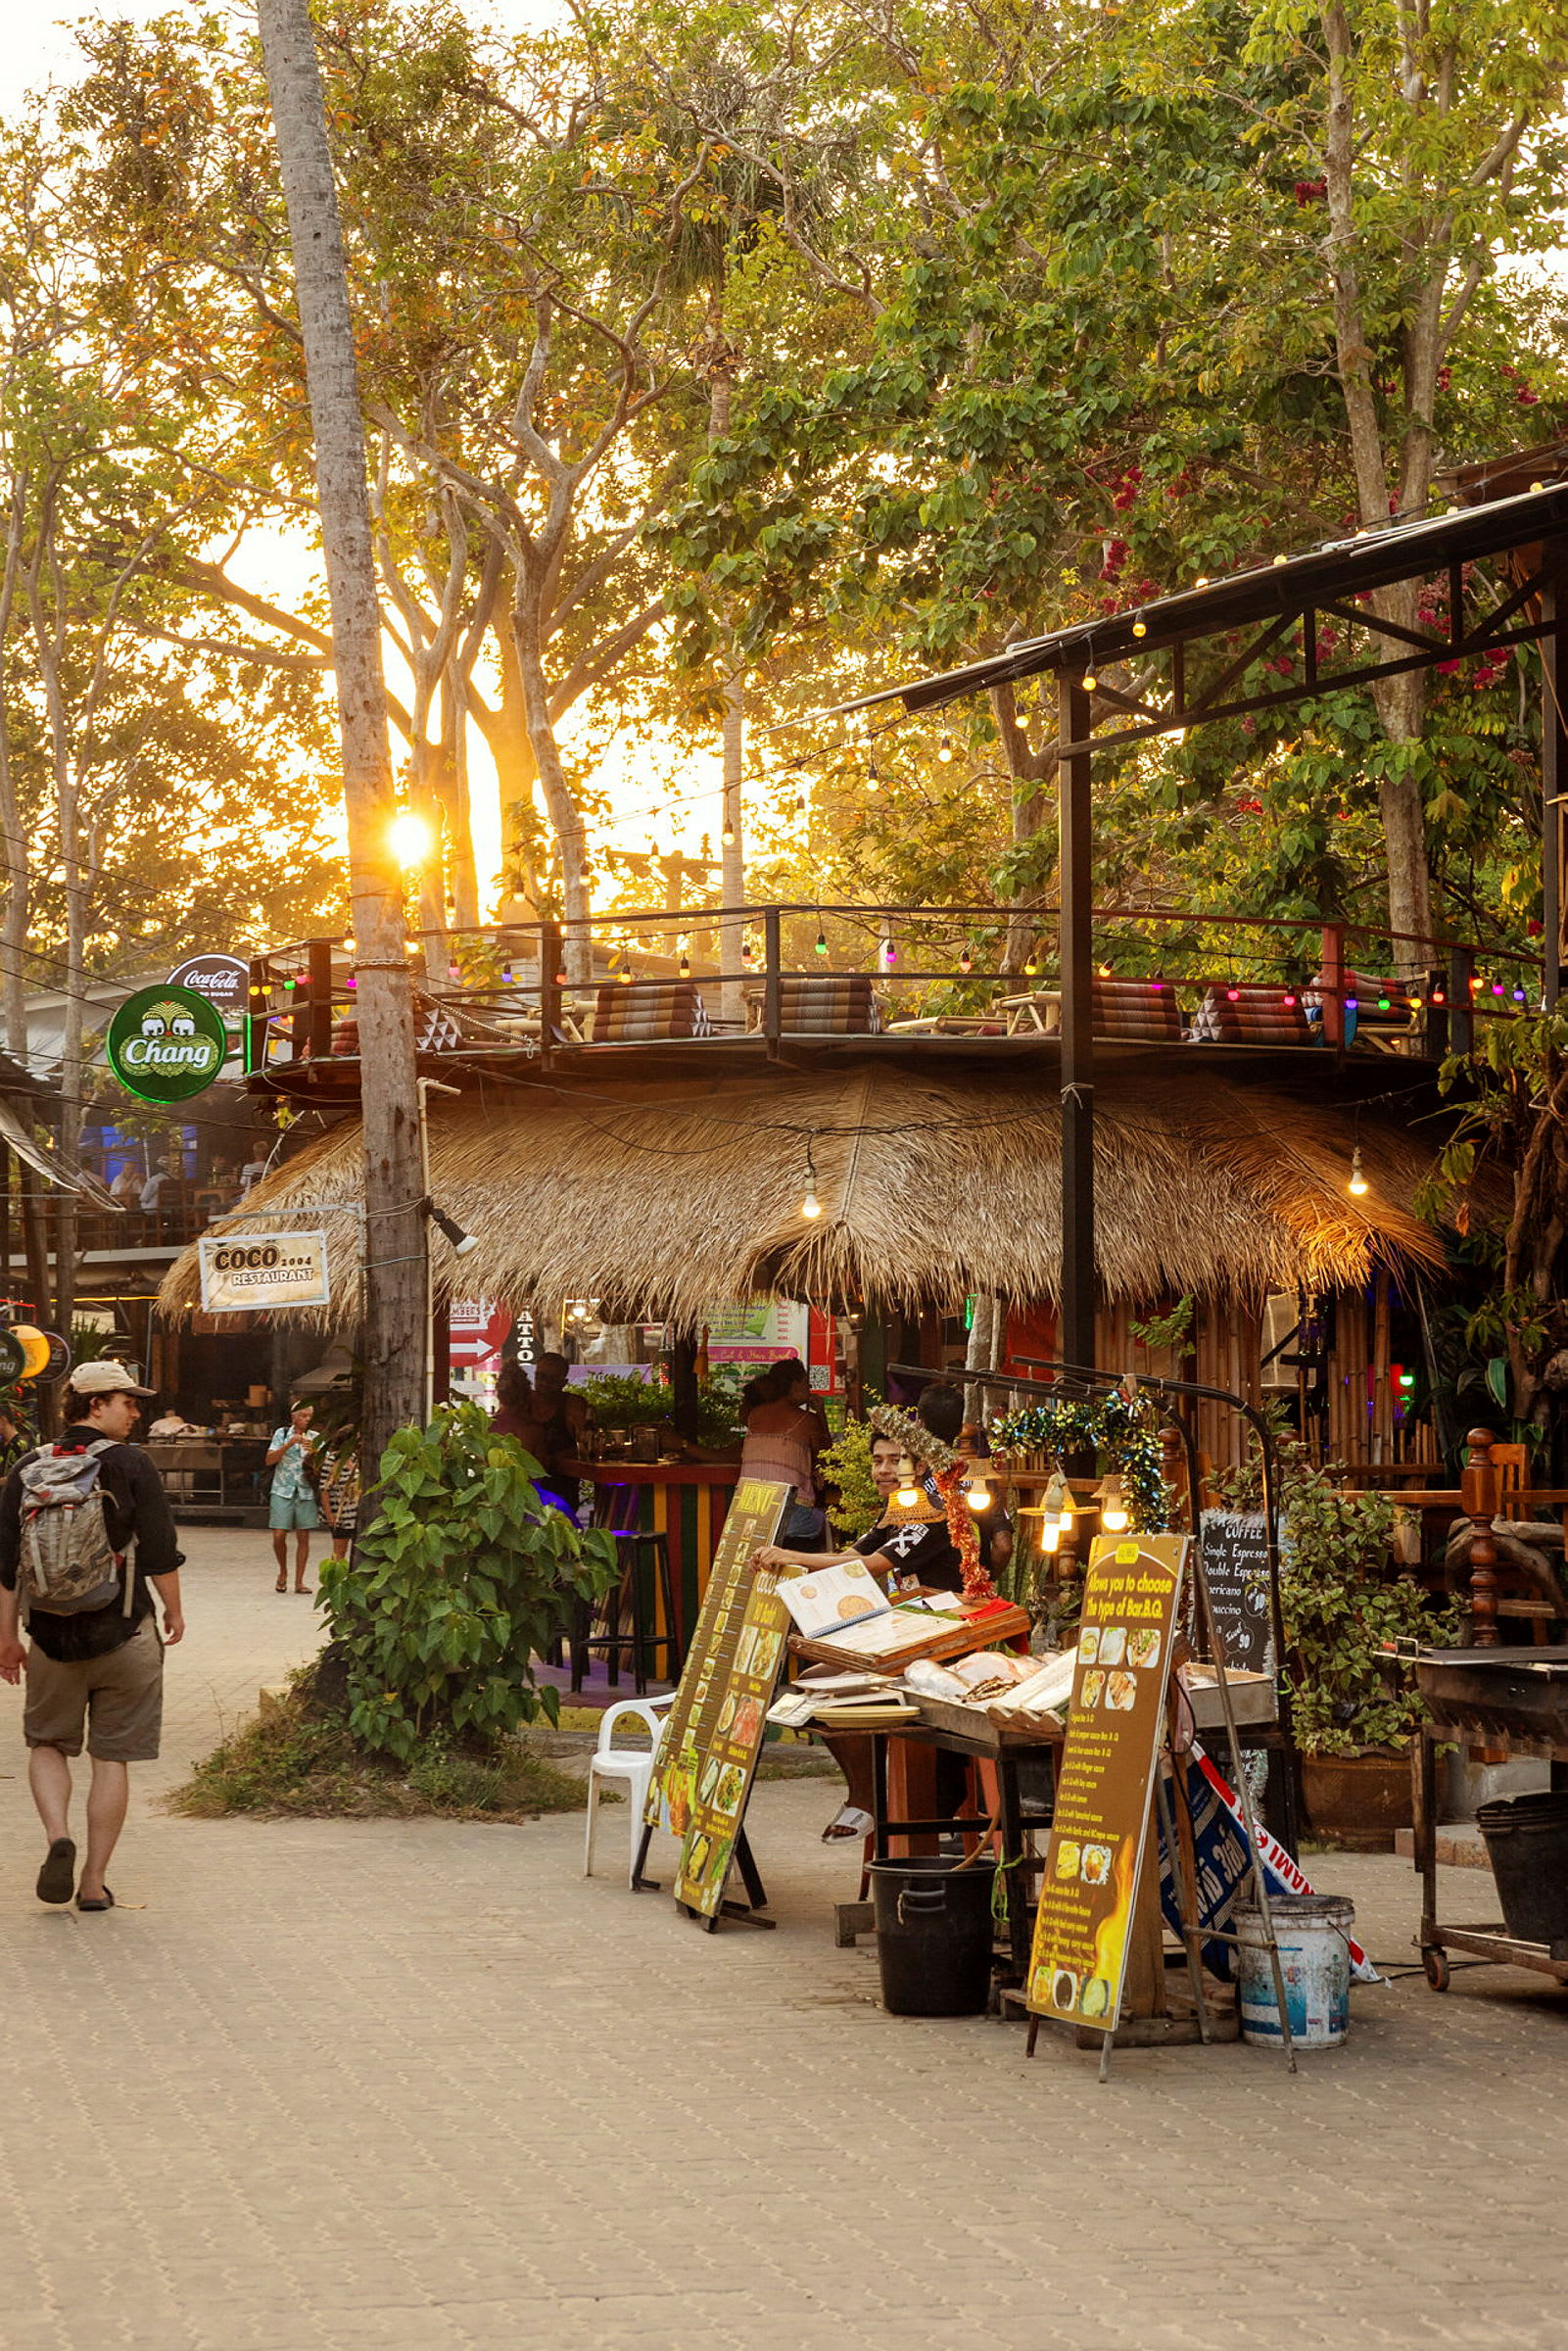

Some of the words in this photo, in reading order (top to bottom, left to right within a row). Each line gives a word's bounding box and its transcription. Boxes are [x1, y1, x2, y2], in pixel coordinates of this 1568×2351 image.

[125, 1038, 211, 1069] Chang
[214, 1245, 280, 1272] COCO
[281, 1256, 312, 1267] 2004
[232, 1269, 314, 1286] RESTAURANT
[516, 1307, 534, 1367] ATTO
[1225, 1525, 1262, 1539] COFFEE
[1205, 1542, 1227, 1560] Single
[1232, 1543, 1268, 1563] Espresso
[1109, 1578, 1124, 1598] you
[1126, 1573, 1135, 1592] to
[1137, 1570, 1173, 1594] choose
[1098, 1598, 1115, 1622] type
[1117, 1596, 1127, 1616] of
